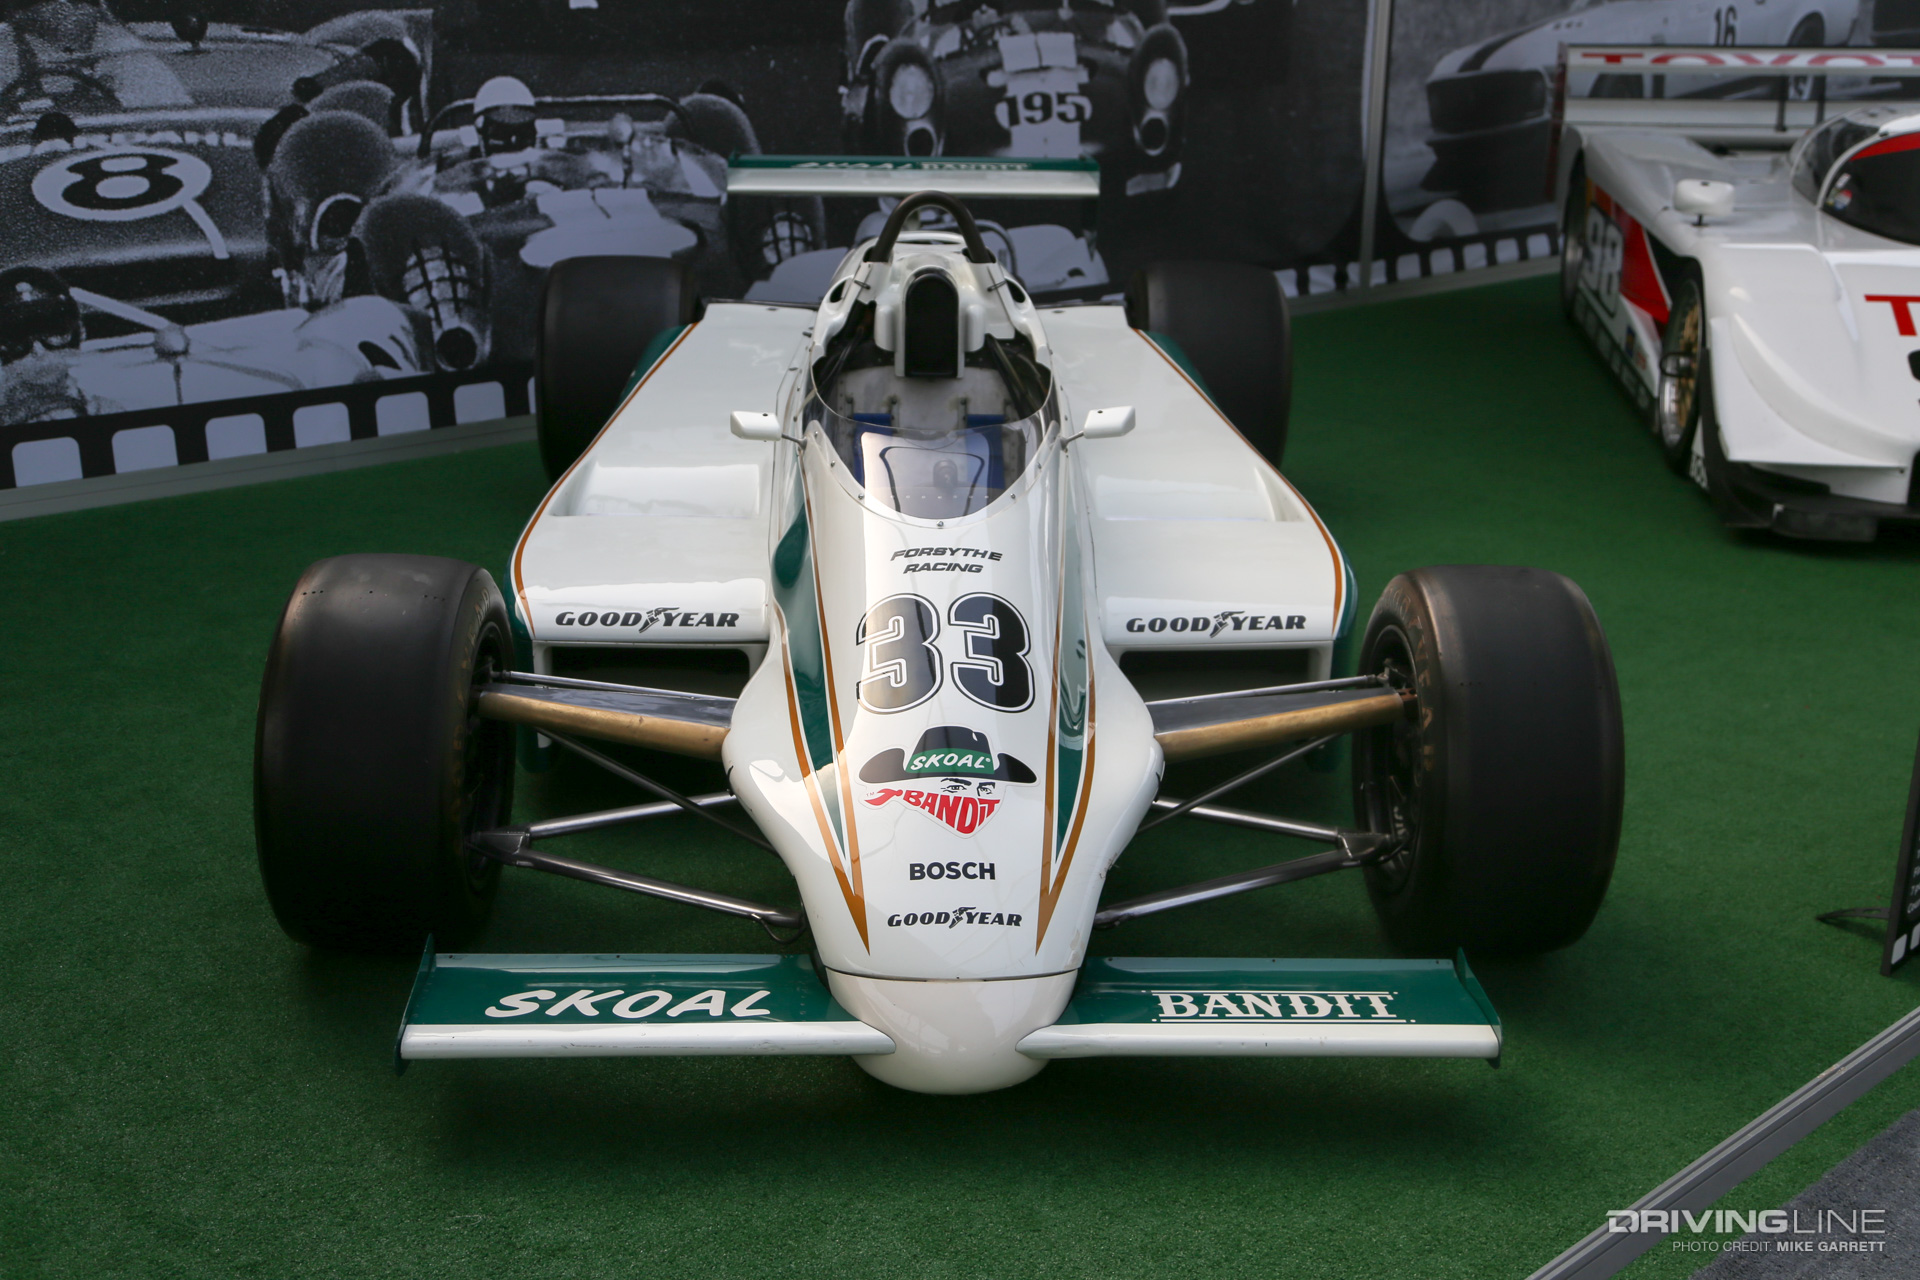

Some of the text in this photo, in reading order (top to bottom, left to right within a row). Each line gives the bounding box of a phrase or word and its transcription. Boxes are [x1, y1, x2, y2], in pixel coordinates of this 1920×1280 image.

[1003, 91, 1085, 128] 195
[61, 153, 184, 210] 8
[890, 547, 1003, 562] FORSYTHE
[903, 562, 984, 574] RACING
[856, 591, 1036, 714] 33
[902, 789, 1001, 835] BANDIT
[909, 861, 996, 881] BOSCH
[484, 989, 771, 1018] SKOAL
[1151, 993, 1398, 1018] BANDIT
